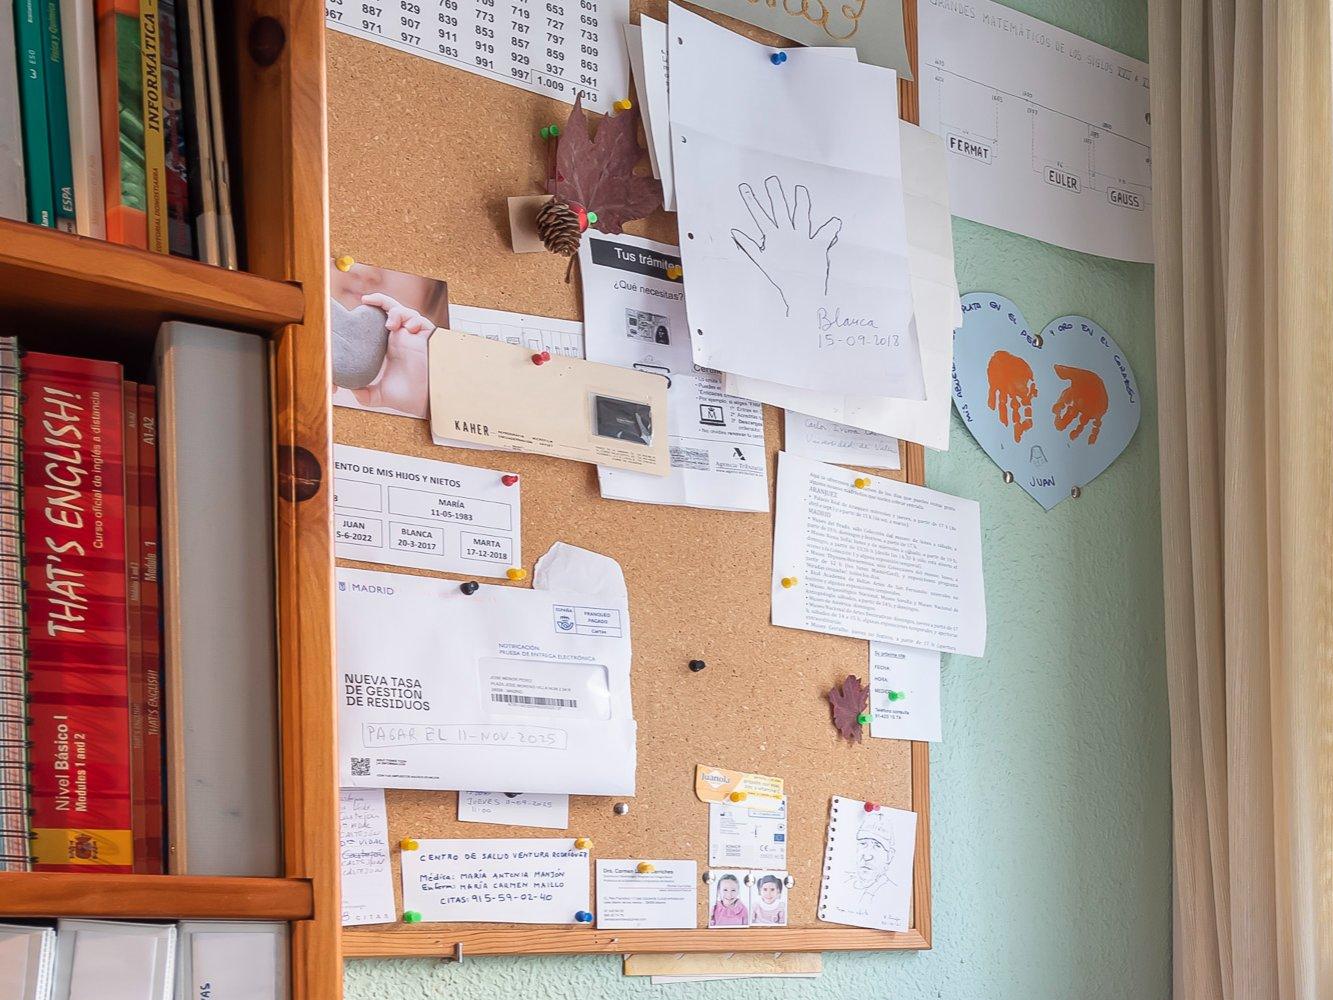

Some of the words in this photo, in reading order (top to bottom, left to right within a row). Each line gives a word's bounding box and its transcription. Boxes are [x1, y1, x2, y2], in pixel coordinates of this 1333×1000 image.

[546, 3, 565, 16] 653
[580, 14, 598, 28] 659
[580, 0, 597, 13] 601
[475, 9, 494, 23] 773
[511, 21, 530, 34] 787
[546, 32, 565, 46] 797
[580, 44, 599, 57] 809
[511, 5, 530, 19] 719
[546, 17, 565, 31] 727
[580, 29, 599, 43] 733
[361, 3, 383, 18] 887
[400, 16, 421, 30] 907
[438, 28, 458, 43] 911
[475, 40, 494, 54] 919
[511, 52, 530, 65] 929
[546, 63, 565, 76] 937
[580, 74, 598, 87] 941
[400, 0, 421, 15] 829
[438, 13, 458, 27] 839
[475, 25, 494, 39] 853
[511, 36, 530, 50] 857
[546, 48, 565, 61] 859
[580, 59, 599, 72] 863
[362, 19, 383, 34] 971
[400, 32, 421, 46] 977
[438, 44, 458, 58] 983
[475, 56, 494, 69] 991
[511, 67, 530, 80] 997
[537, 76, 565, 92] 1.009
[571, 87, 598, 102] 1013
[142, 12, 160, 133] INFORMÁTICA
[949, 136, 989, 159] FERMAT
[1049, 169, 1078, 191] EULER
[61, 186, 73, 213] ESPA
[1110, 190, 1140, 208] GAUSS
[613, 247, 636, 263] Tus
[613, 280, 638, 293] ¿Qué
[639, 286, 684, 301] necesitas?
[816, 307, 879, 330] Blanca
[1057, 322, 1073, 332] ORO
[818, 332, 900, 349] 15-09-2018
[90, 391, 101, 434] distancia
[143, 416, 155, 445] A1-A2
[454, 419, 491, 437] KAHER
[43, 386, 87, 528] ENGLISH!
[91, 444, 104, 472] inglés
[92, 475, 102, 487] de
[362, 466, 374, 476] DE
[376, 467, 394, 478] MIS
[395, 471, 420, 482] HIJOS
[422, 475, 428, 484] Y
[429, 476, 461, 488] NIETOS
[1029, 474, 1056, 488] JUAN
[92, 489, 102, 518] oficial
[438, 498, 465, 509] MARÍA
[430, 508, 473, 521] 11-05-1983
[92, 519, 103, 549] Curso
[343, 520, 365, 530] JUAN
[401, 528, 433, 539] BLANCA
[397, 538, 437, 551] 20-3-2017
[472, 538, 501, 549] MARTA
[466, 548, 508, 560] 17-12-2018
[46, 537, 87, 637] THAT'S
[352, 582, 395, 595] MADRID
[344, 673, 388, 686] NUEVA
[390, 676, 422, 689] TASA
[345, 685, 363, 695] DE
[346, 696, 364, 706] DE
[366, 697, 431, 711] RESIDUOS
[148, 709, 159, 736] THAT'S
[367, 725, 418, 744] PAGAR
[425, 727, 448, 741] EL
[54, 724, 70, 770] Básico
[74, 741, 86, 759] and
[701, 772, 730, 784] Juanola
[55, 775, 70, 811] Nivel
[75, 770, 87, 812] Modules
[419, 853, 459, 862] CENTRO
[481, 852, 509, 860] SALUD
[512, 851, 549, 859] VENTURA
[460, 869, 487, 879] MARÍA
[459, 881, 488, 889] MARÍA
[440, 896, 470, 905] CITAS:
[471, 894, 553, 903] 915-59-02-40
